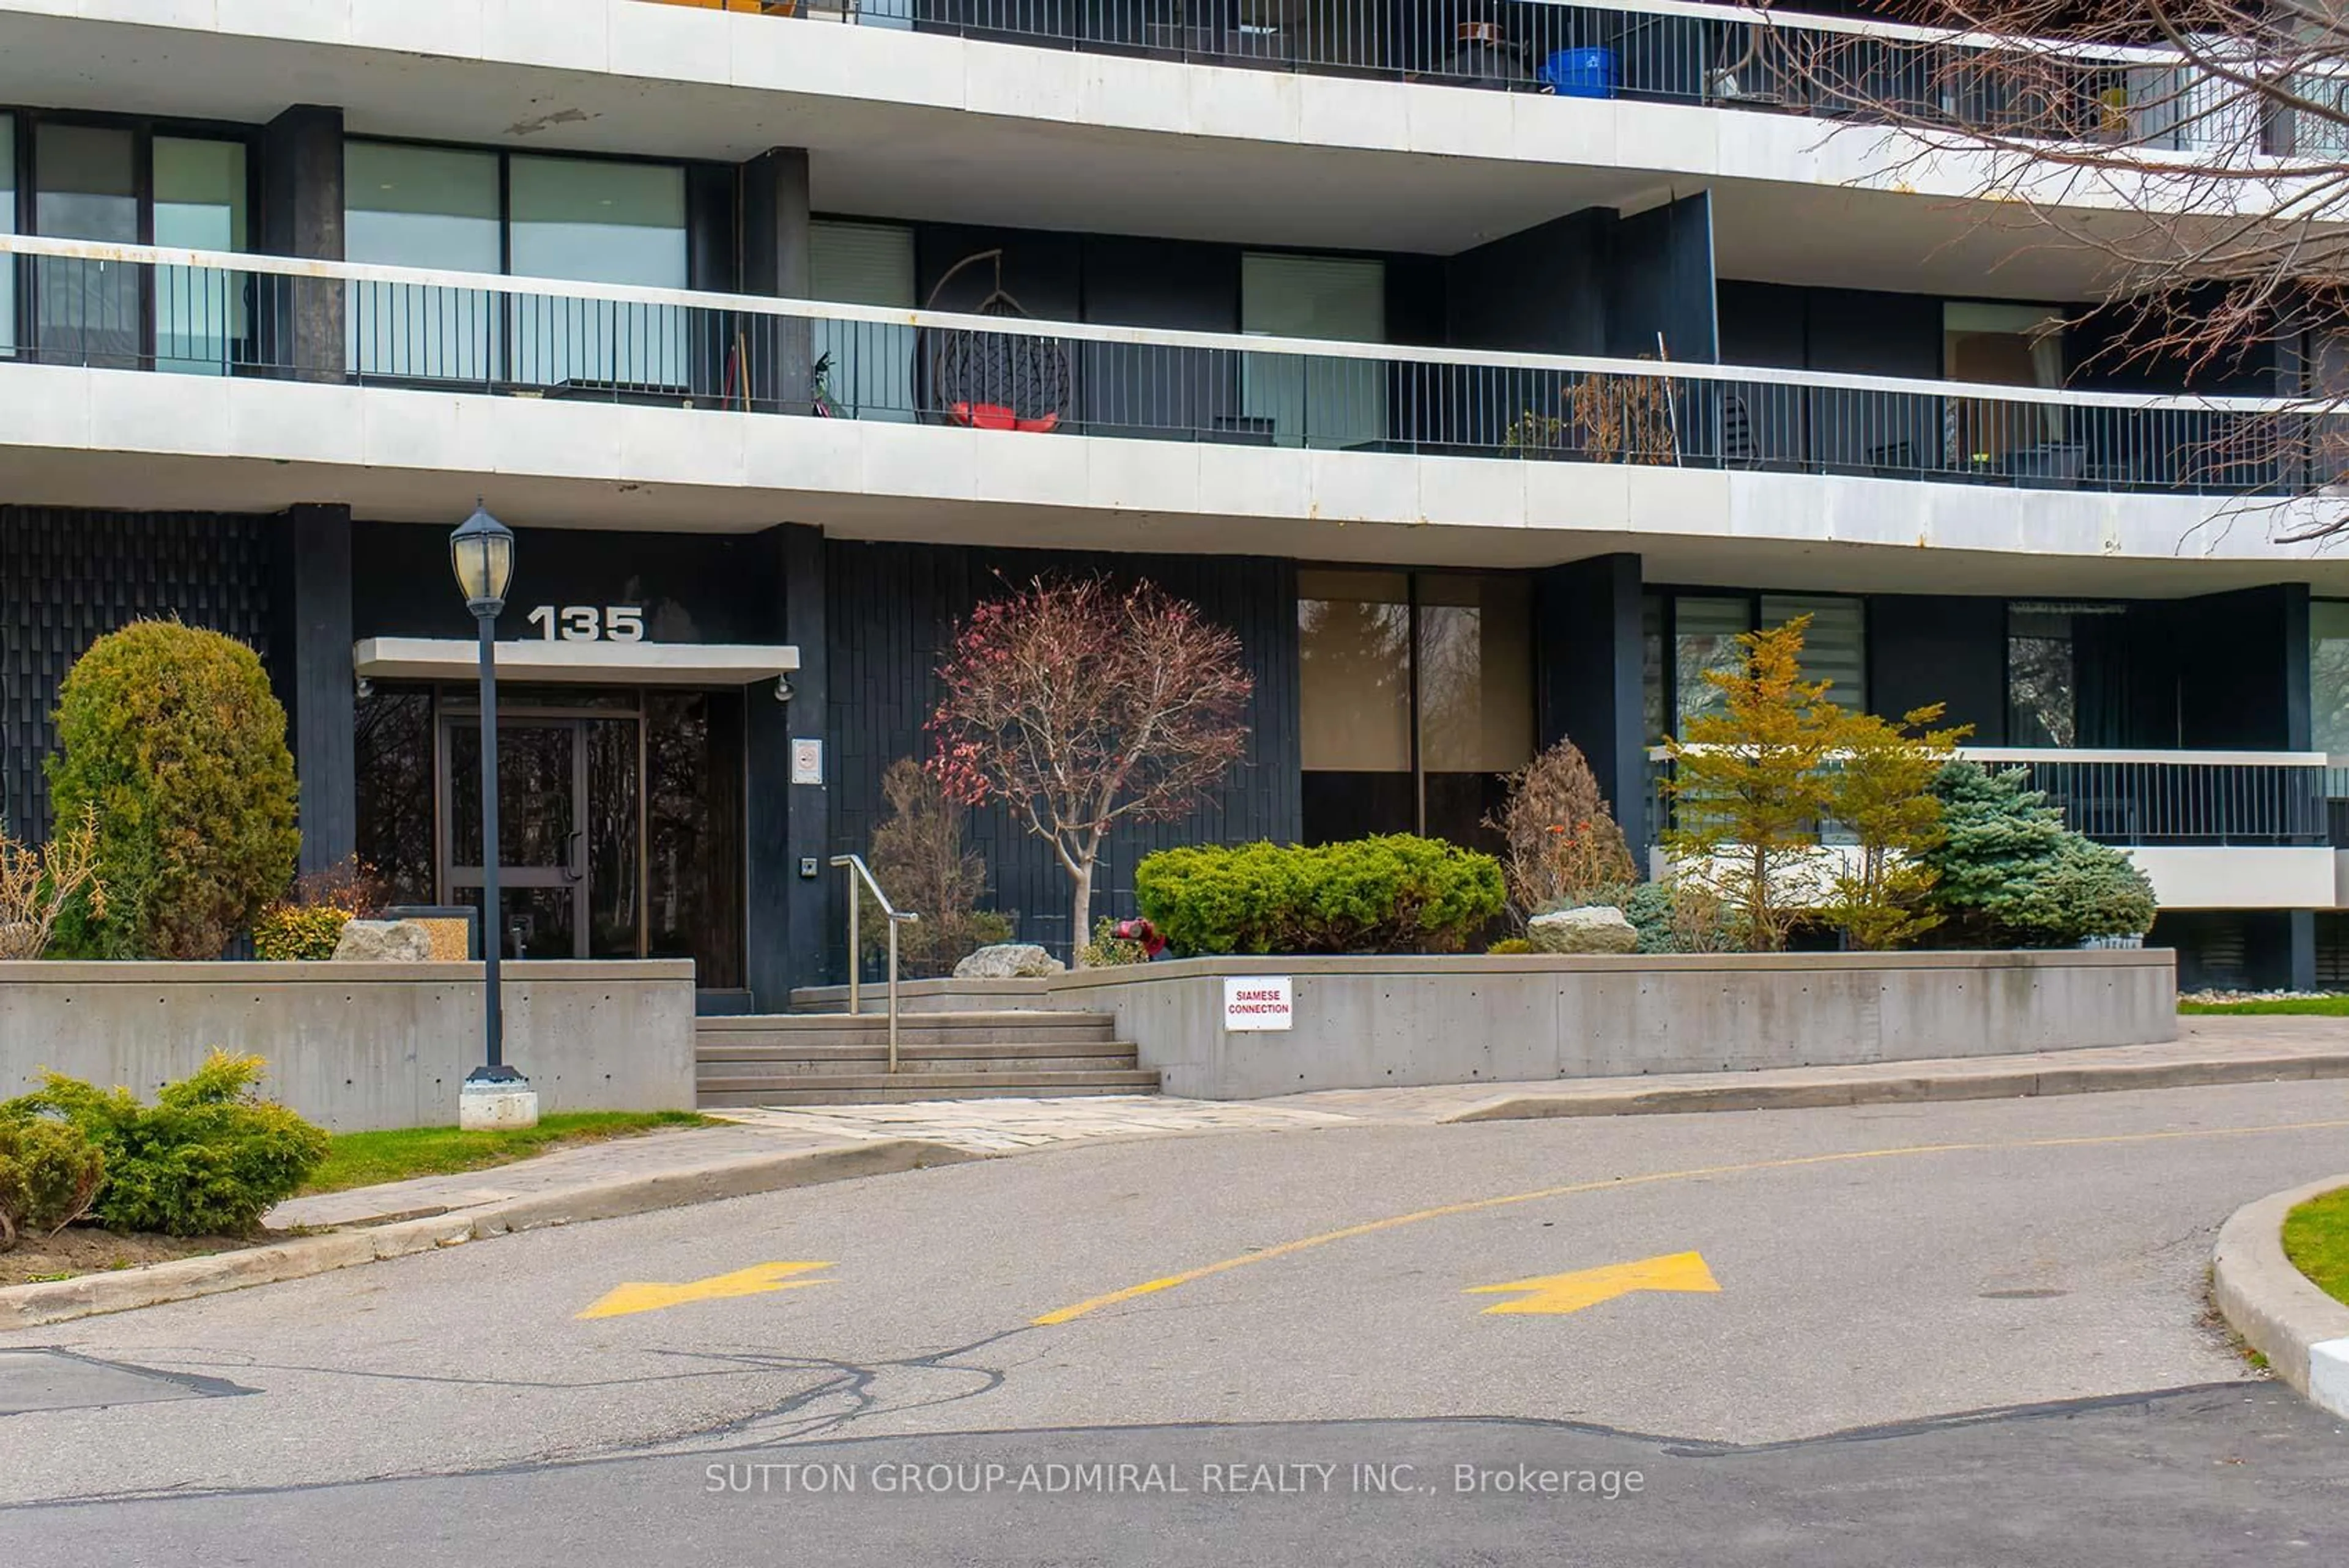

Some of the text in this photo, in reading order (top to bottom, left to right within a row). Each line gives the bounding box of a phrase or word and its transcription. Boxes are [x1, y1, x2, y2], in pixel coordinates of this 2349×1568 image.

[527, 605, 644, 642] 135
[1236, 990, 1280, 1001] SIAMESE
[1228, 1004, 1289, 1014] CONNECTION
